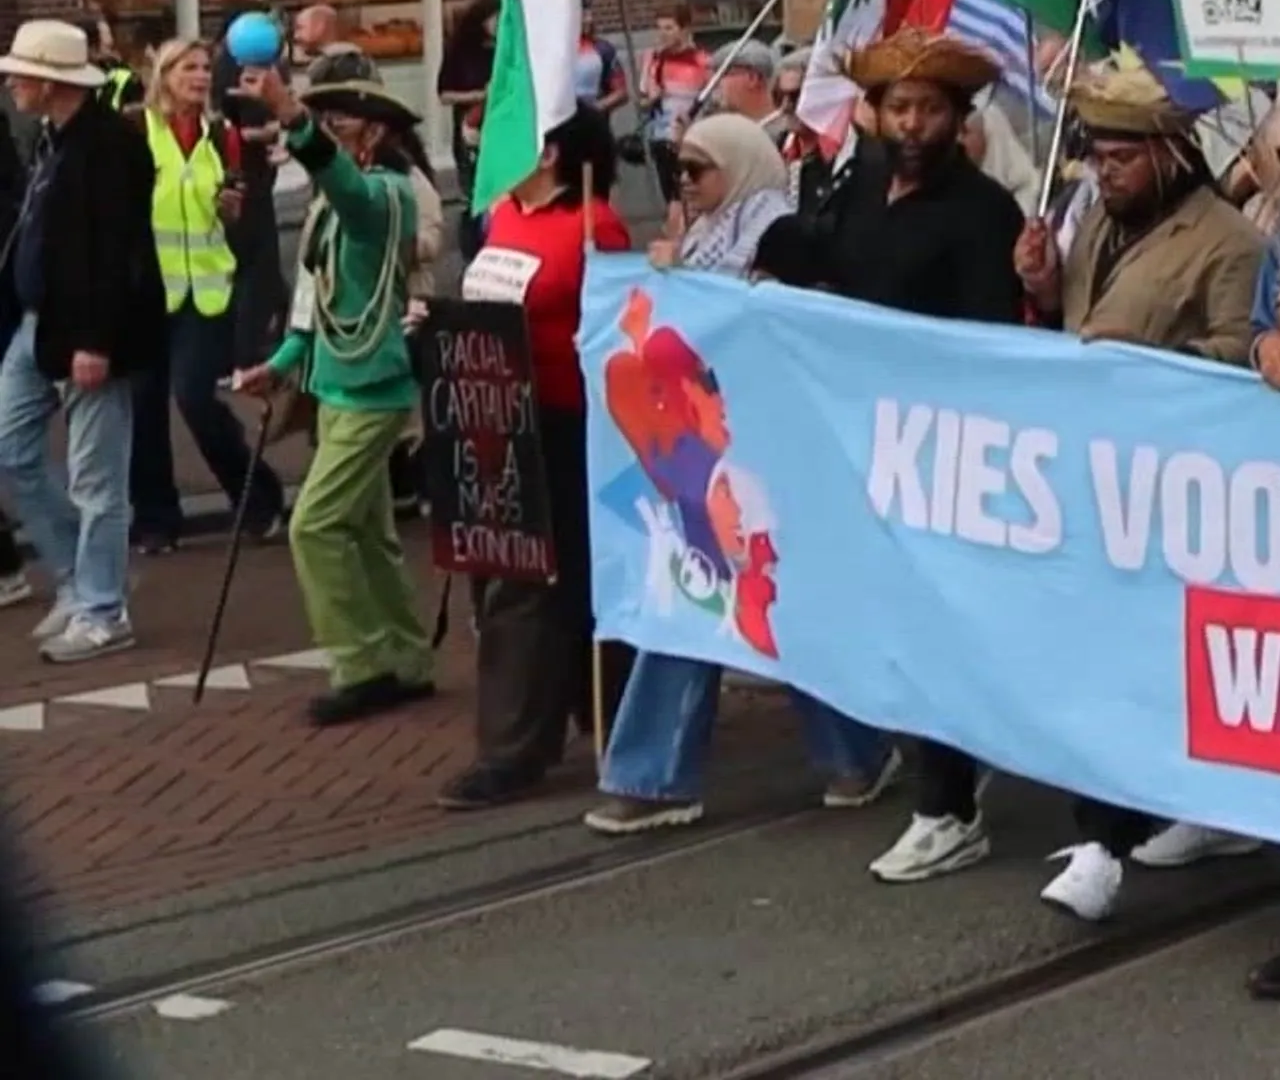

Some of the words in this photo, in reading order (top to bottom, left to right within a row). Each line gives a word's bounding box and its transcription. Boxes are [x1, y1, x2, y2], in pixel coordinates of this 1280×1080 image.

[435, 330, 513, 376] RACIAL
[453, 439, 479, 483] IS
[501, 440, 521, 487] A
[868, 396, 1062, 554] KIES
[458, 482, 523, 523] MASS
[453, 521, 549, 574] EXTINCTION
